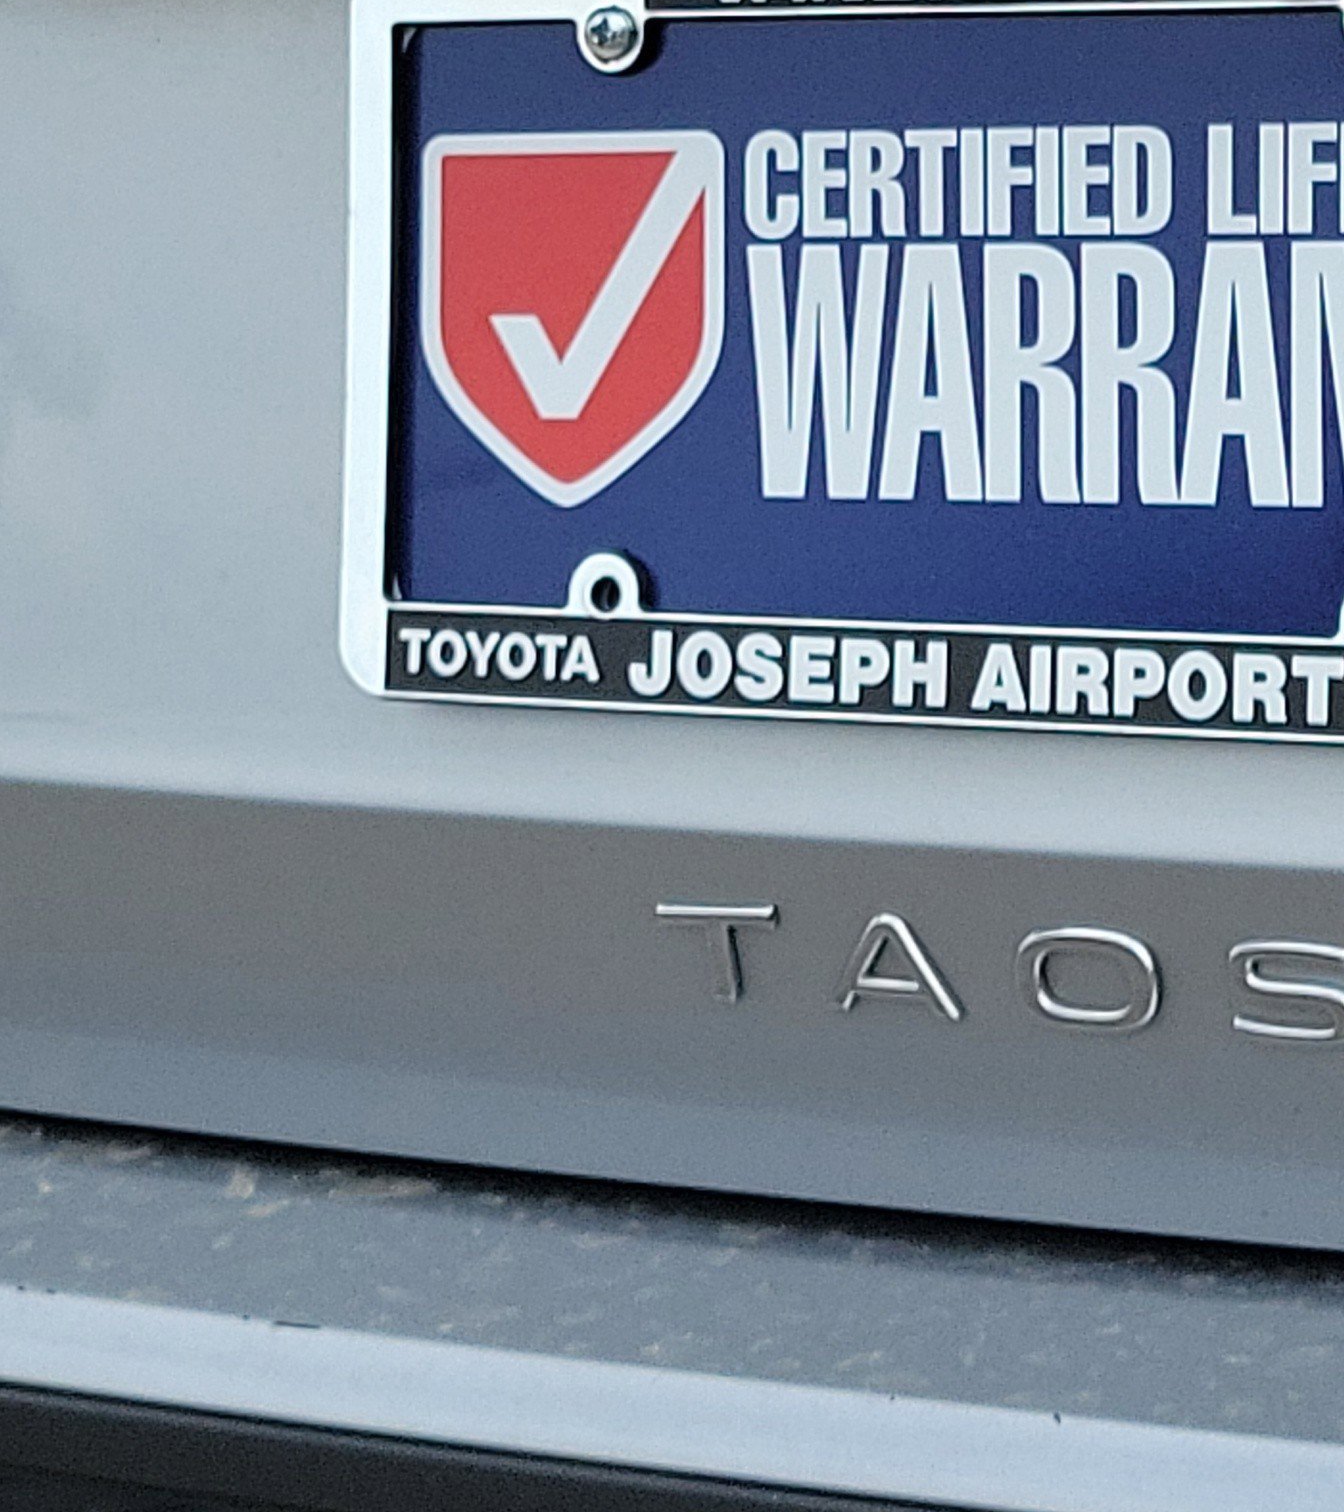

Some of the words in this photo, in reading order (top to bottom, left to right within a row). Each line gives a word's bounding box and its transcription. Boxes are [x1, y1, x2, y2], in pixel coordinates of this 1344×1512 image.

[743, 124, 1175, 240] CERTIFIED
[397, 626, 602, 685] TOYOTA
[627, 628, 951, 710] JOSEPH
